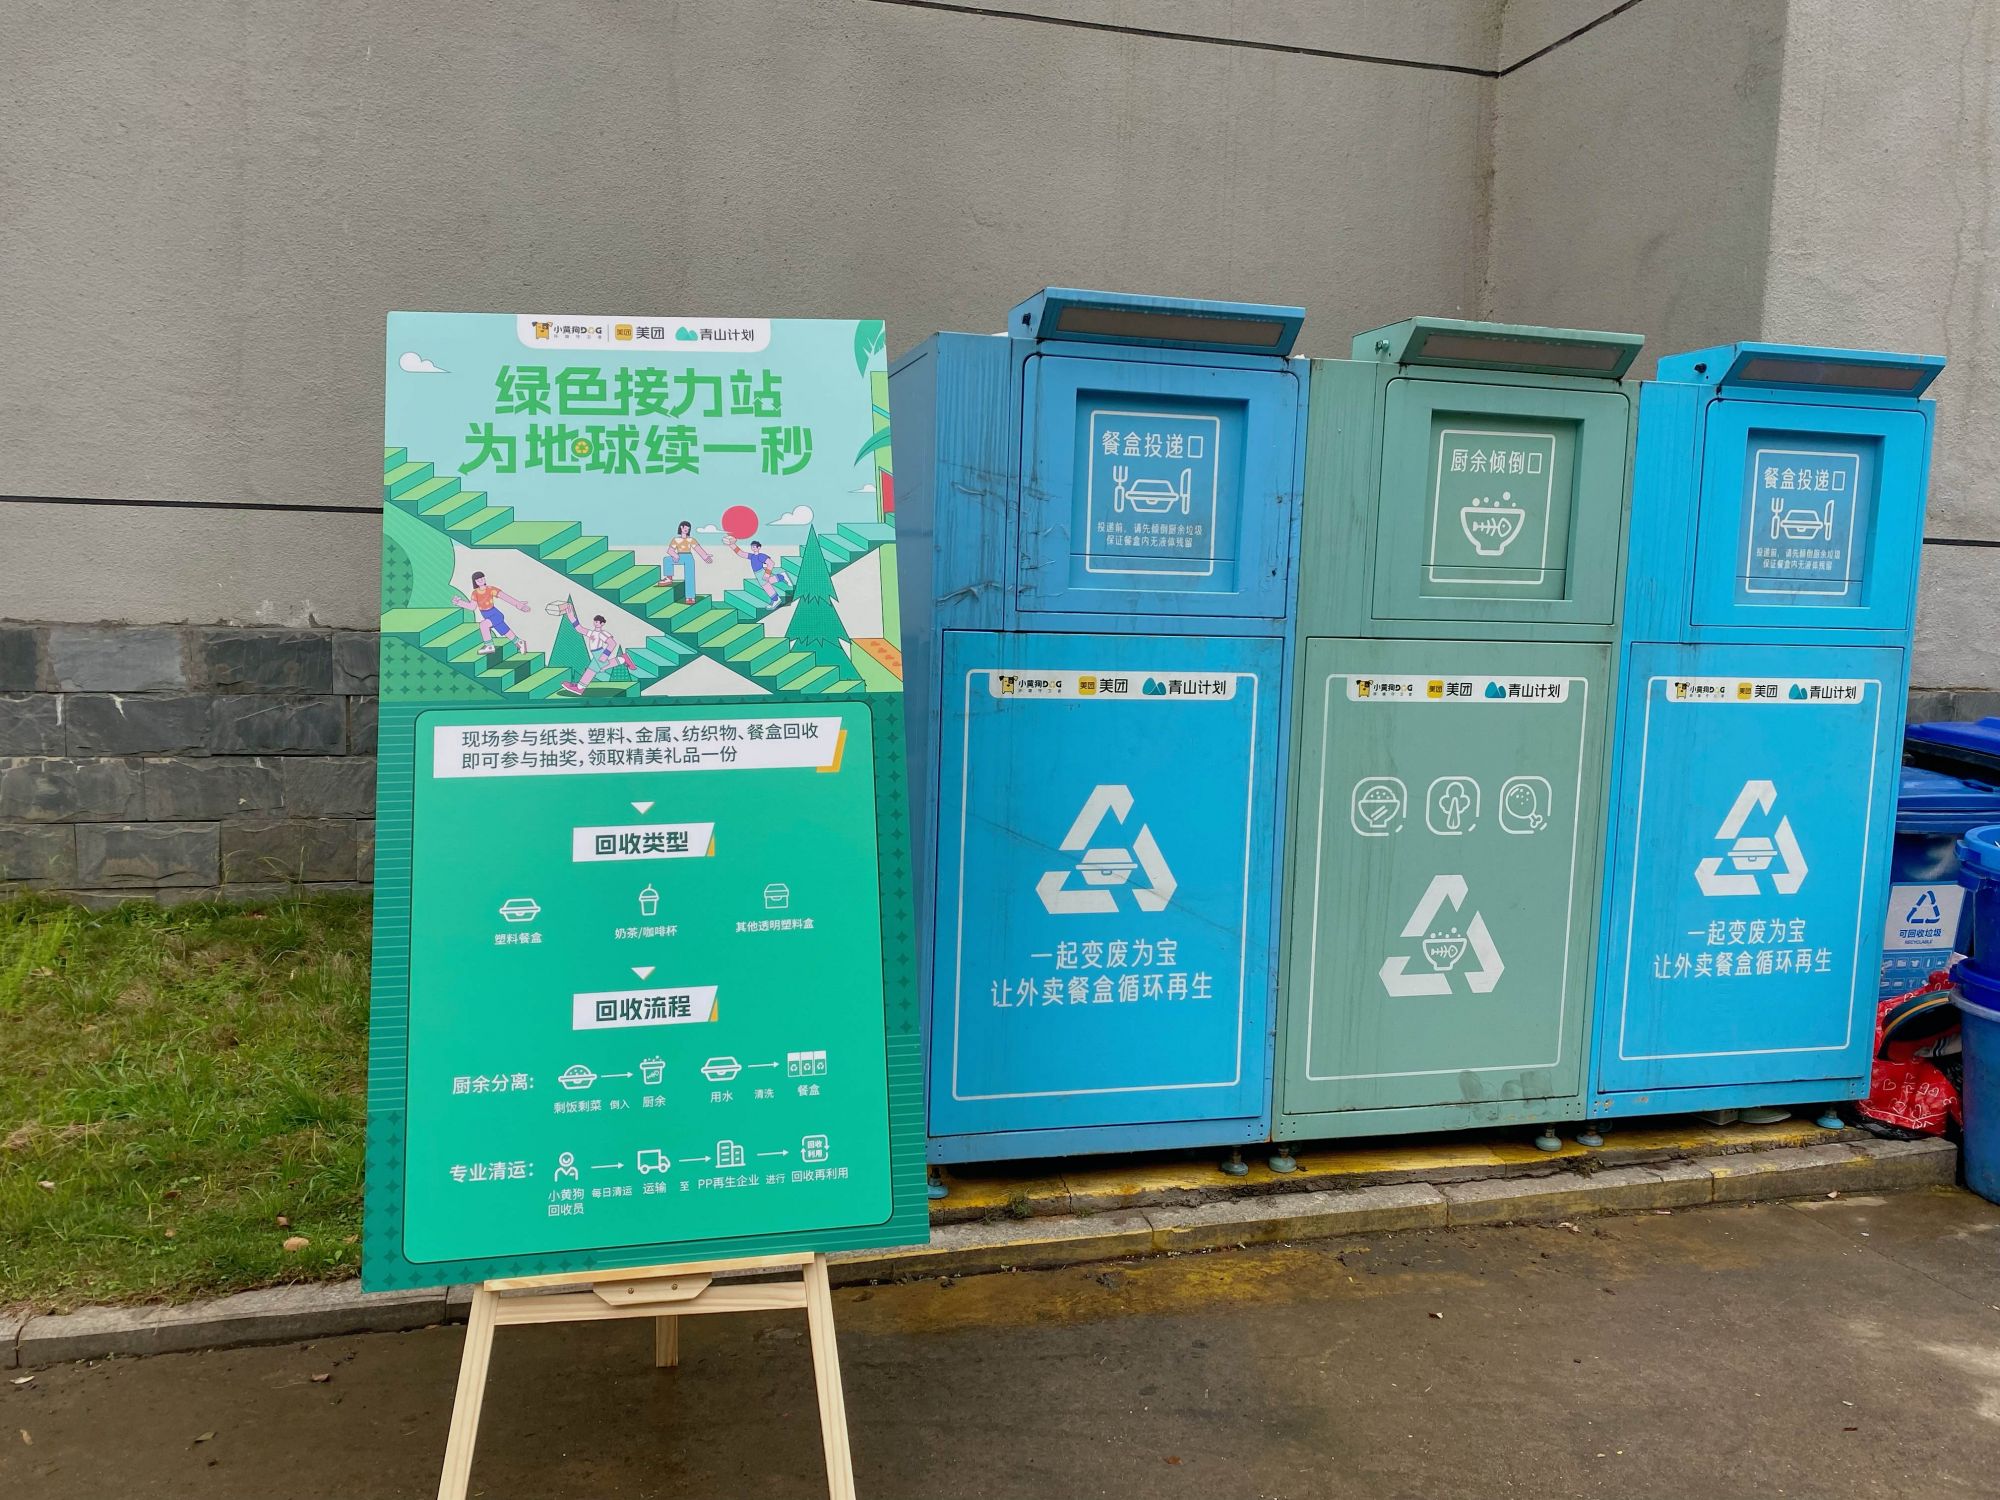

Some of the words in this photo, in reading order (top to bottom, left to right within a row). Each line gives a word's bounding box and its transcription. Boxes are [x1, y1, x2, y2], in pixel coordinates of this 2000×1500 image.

[637, 327, 665, 339] 美团
[700, 329, 754, 341] 青山计划
[495, 365, 782, 418] 绿色接力站
[457, 423, 813, 476] 为地球续一秒
[1102, 430, 1203, 459] 餐盒投递口
[1451, 449, 1543, 474] 厨余倾倒口
[1763, 467, 1846, 492] 餐盒投递口
[1099, 679, 1128, 694] 美团
[1168, 680, 1226, 695] 青山计划
[1446, 682, 1473, 697] 美团
[1508, 683, 1560, 698] 青山计划
[1754, 684, 1778, 698] 美团
[1809, 685, 1857, 699] 青山计划
[595, 831, 689, 855] 回收类型
[614, 925, 677, 940] 奶茶/咖啡杯
[735, 918, 815, 933] 其他透明塑料盒
[1688, 918, 1806, 946] 一起变废为宝
[1899, 928, 1941, 938] 可回收垃圾
[494, 932, 542, 945] 塑料餐盒
[1030, 938, 1178, 971] 一起变废为宝
[1653, 948, 1832, 980] 让外卖餐盒循环再生
[991, 971, 1213, 1008] 让外卖餐盒循环再生
[595, 995, 692, 1022] 回收流程
[710, 1090, 733, 1103] 用水
[754, 1088, 775, 1099] 清洗
[797, 1084, 820, 1097] 餐盒
[553, 1100, 602, 1114] 剩饭剩菜
[610, 1099, 630, 1110] 倒入
[642, 1095, 666, 1108] 厨余
[698, 1176, 760, 1189] PP再生企业
[765, 1174, 785, 1185] 进行
[791, 1167, 849, 1182] 回收再利用
[548, 1188, 585, 1201] 小黄狗
[591, 1186, 633, 1198] 每日清运
[643, 1181, 667, 1195] 运输
[679, 1181, 689, 1192] 至
[548, 1202, 584, 1216] 回收员
